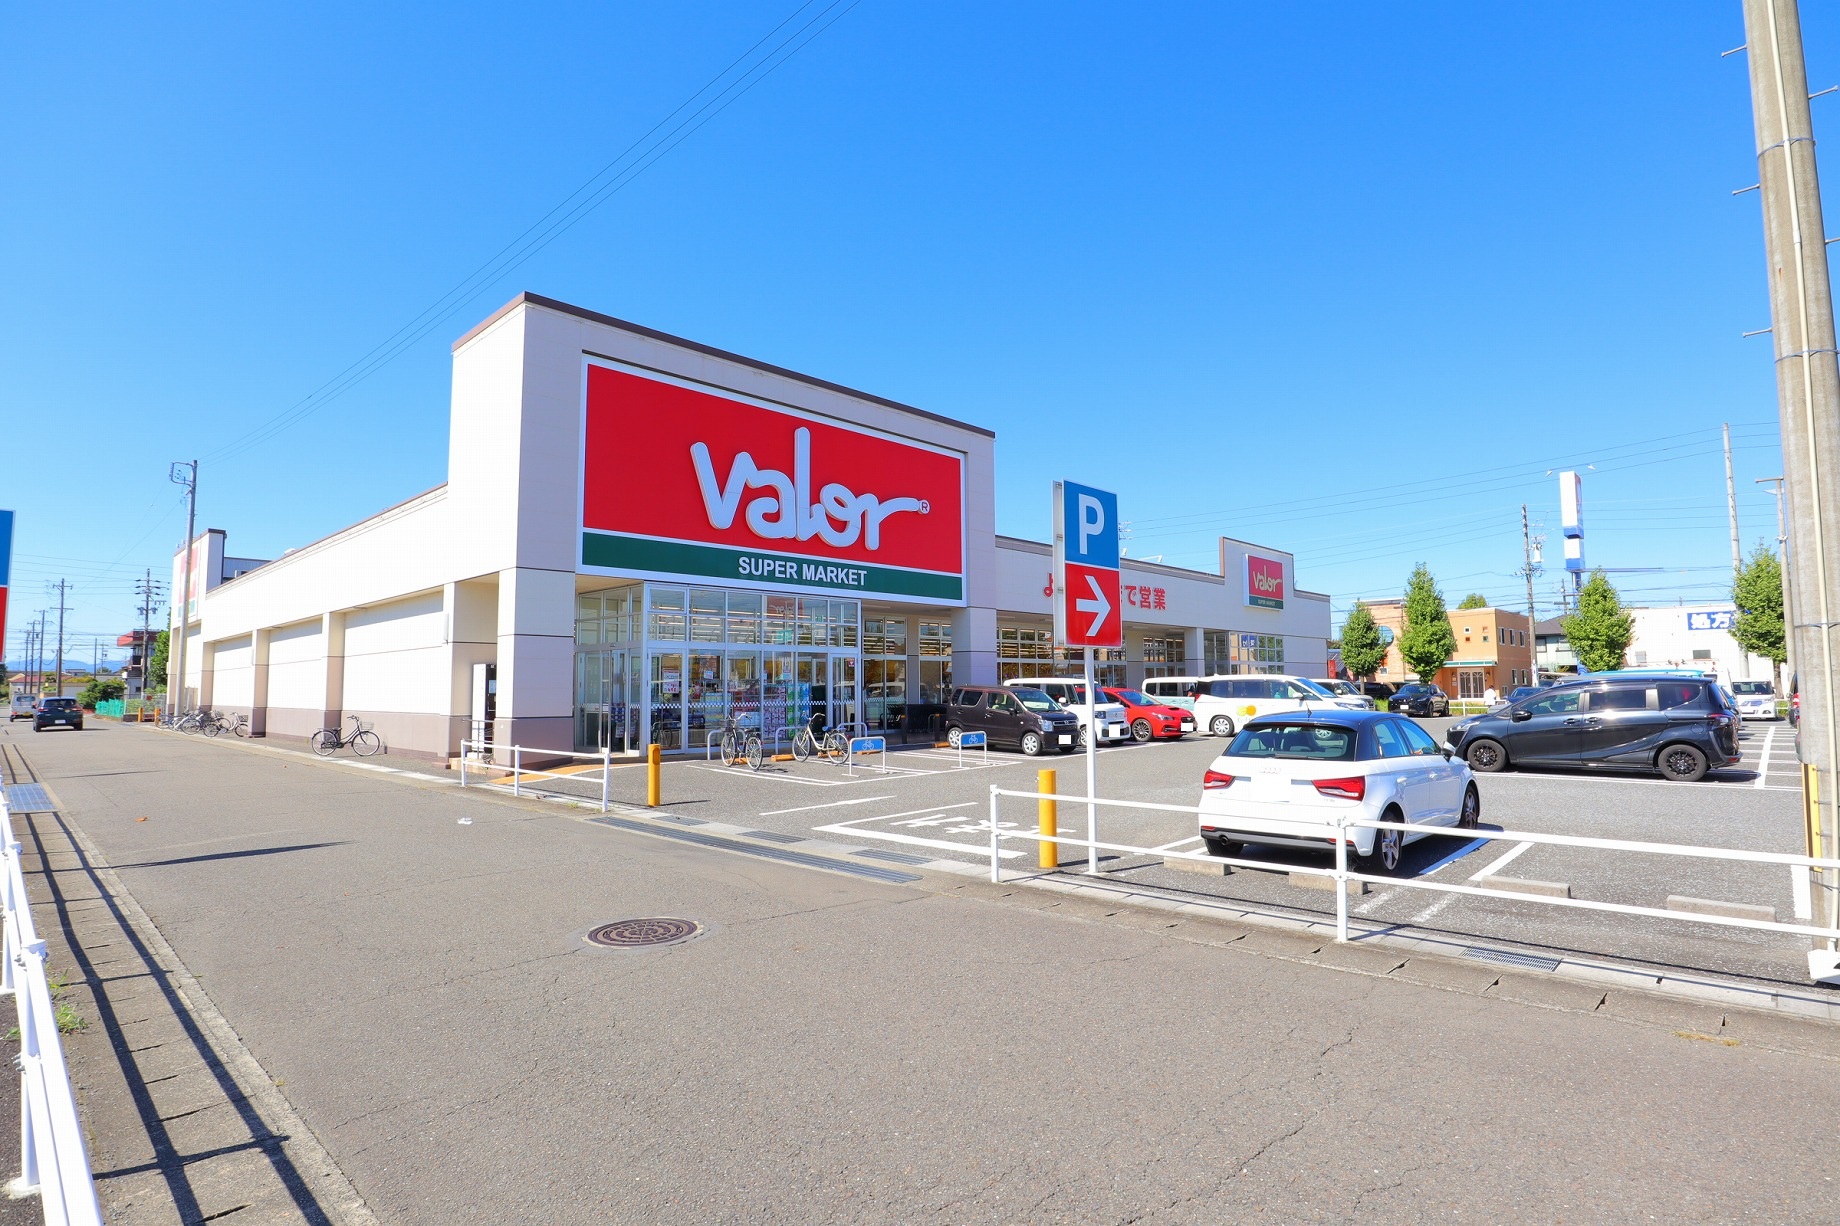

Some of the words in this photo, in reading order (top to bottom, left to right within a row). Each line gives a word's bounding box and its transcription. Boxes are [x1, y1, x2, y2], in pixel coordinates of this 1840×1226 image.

[1079, 493, 1104, 555] P
[738, 556, 798, 579] SUPER
[802, 563, 867, 586] MARKET
